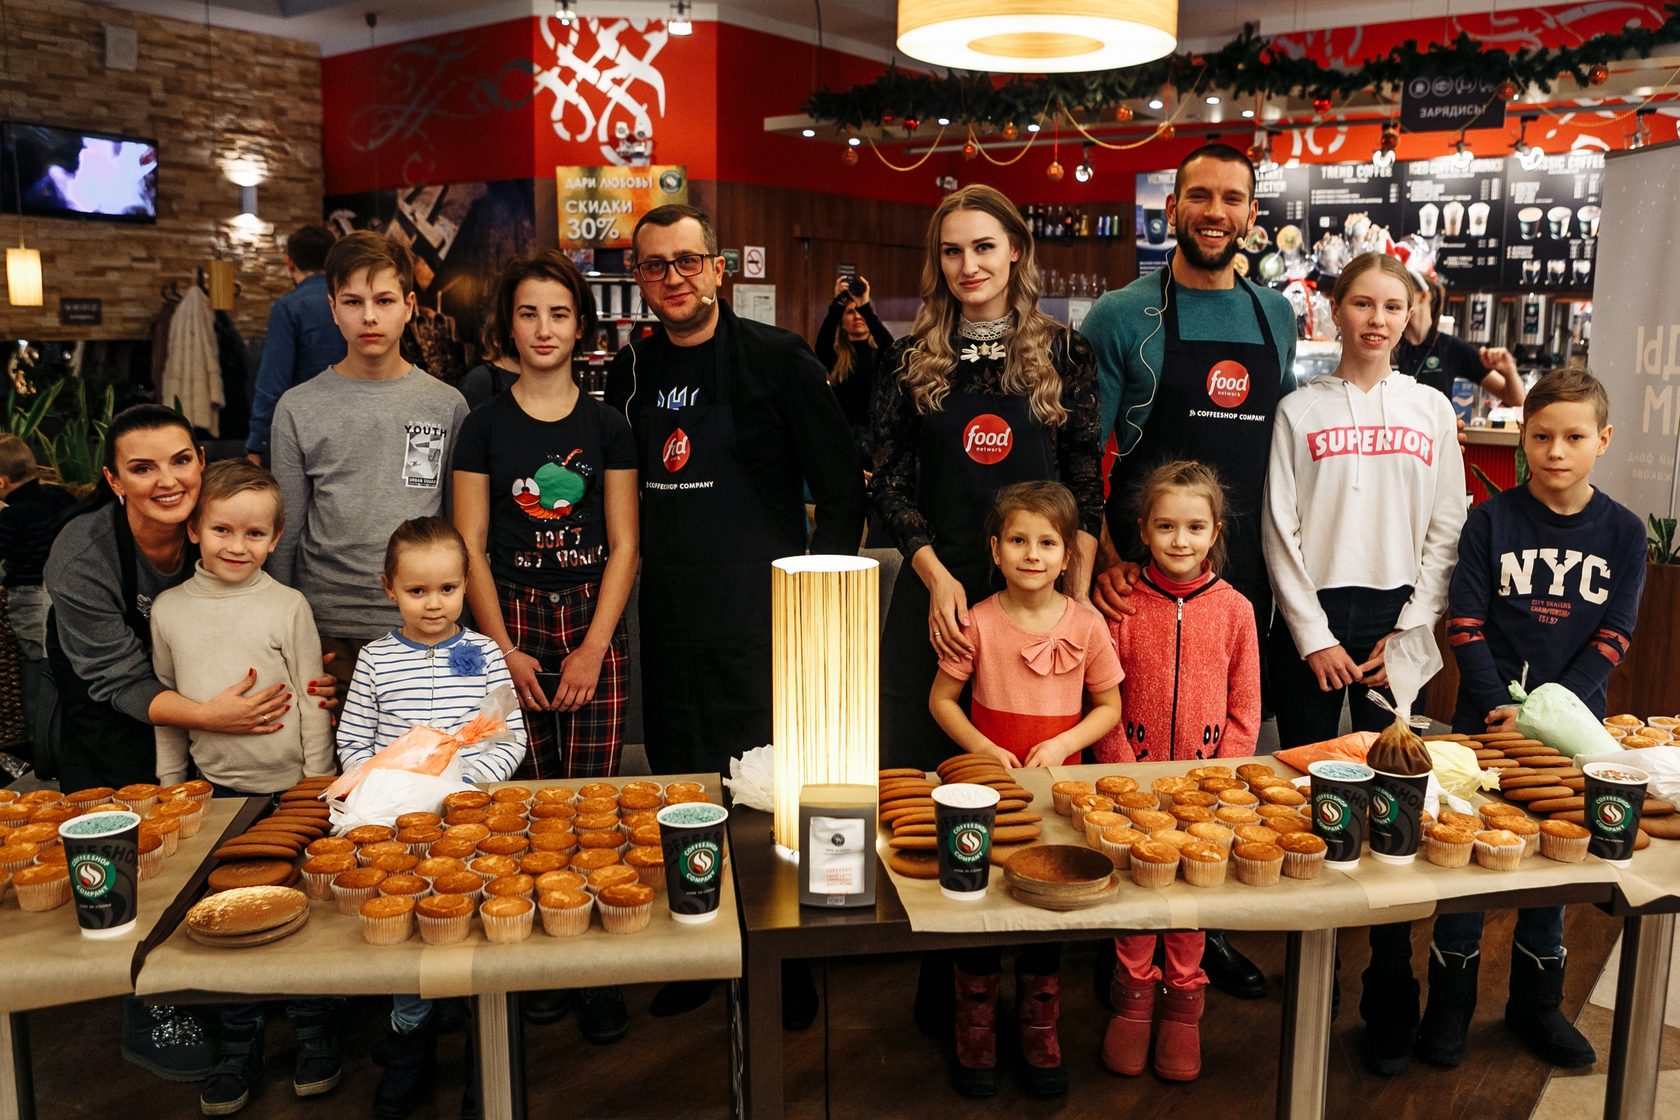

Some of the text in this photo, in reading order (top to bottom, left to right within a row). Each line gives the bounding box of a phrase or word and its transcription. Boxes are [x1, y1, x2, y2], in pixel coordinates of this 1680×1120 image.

[564, 177, 596, 190] ДАРИ
[565, 199, 633, 214] СКИДКИ
[566, 218, 620, 240] 30%
[1208, 369, 1249, 396] food
[1197, 410, 1266, 421] COFFEESHOP COMPANY
[404, 425, 447, 438] YOUTH
[965, 425, 1011, 453] food
[1315, 429, 1430, 460] SUPERIOR
[679, 480, 714, 490] COMPANY
[1498, 548, 1611, 605] NYC
[953, 850, 984, 863] COMPANY
[685, 871, 716, 883] COMPANY
[76, 885, 109, 898] COMPANY
